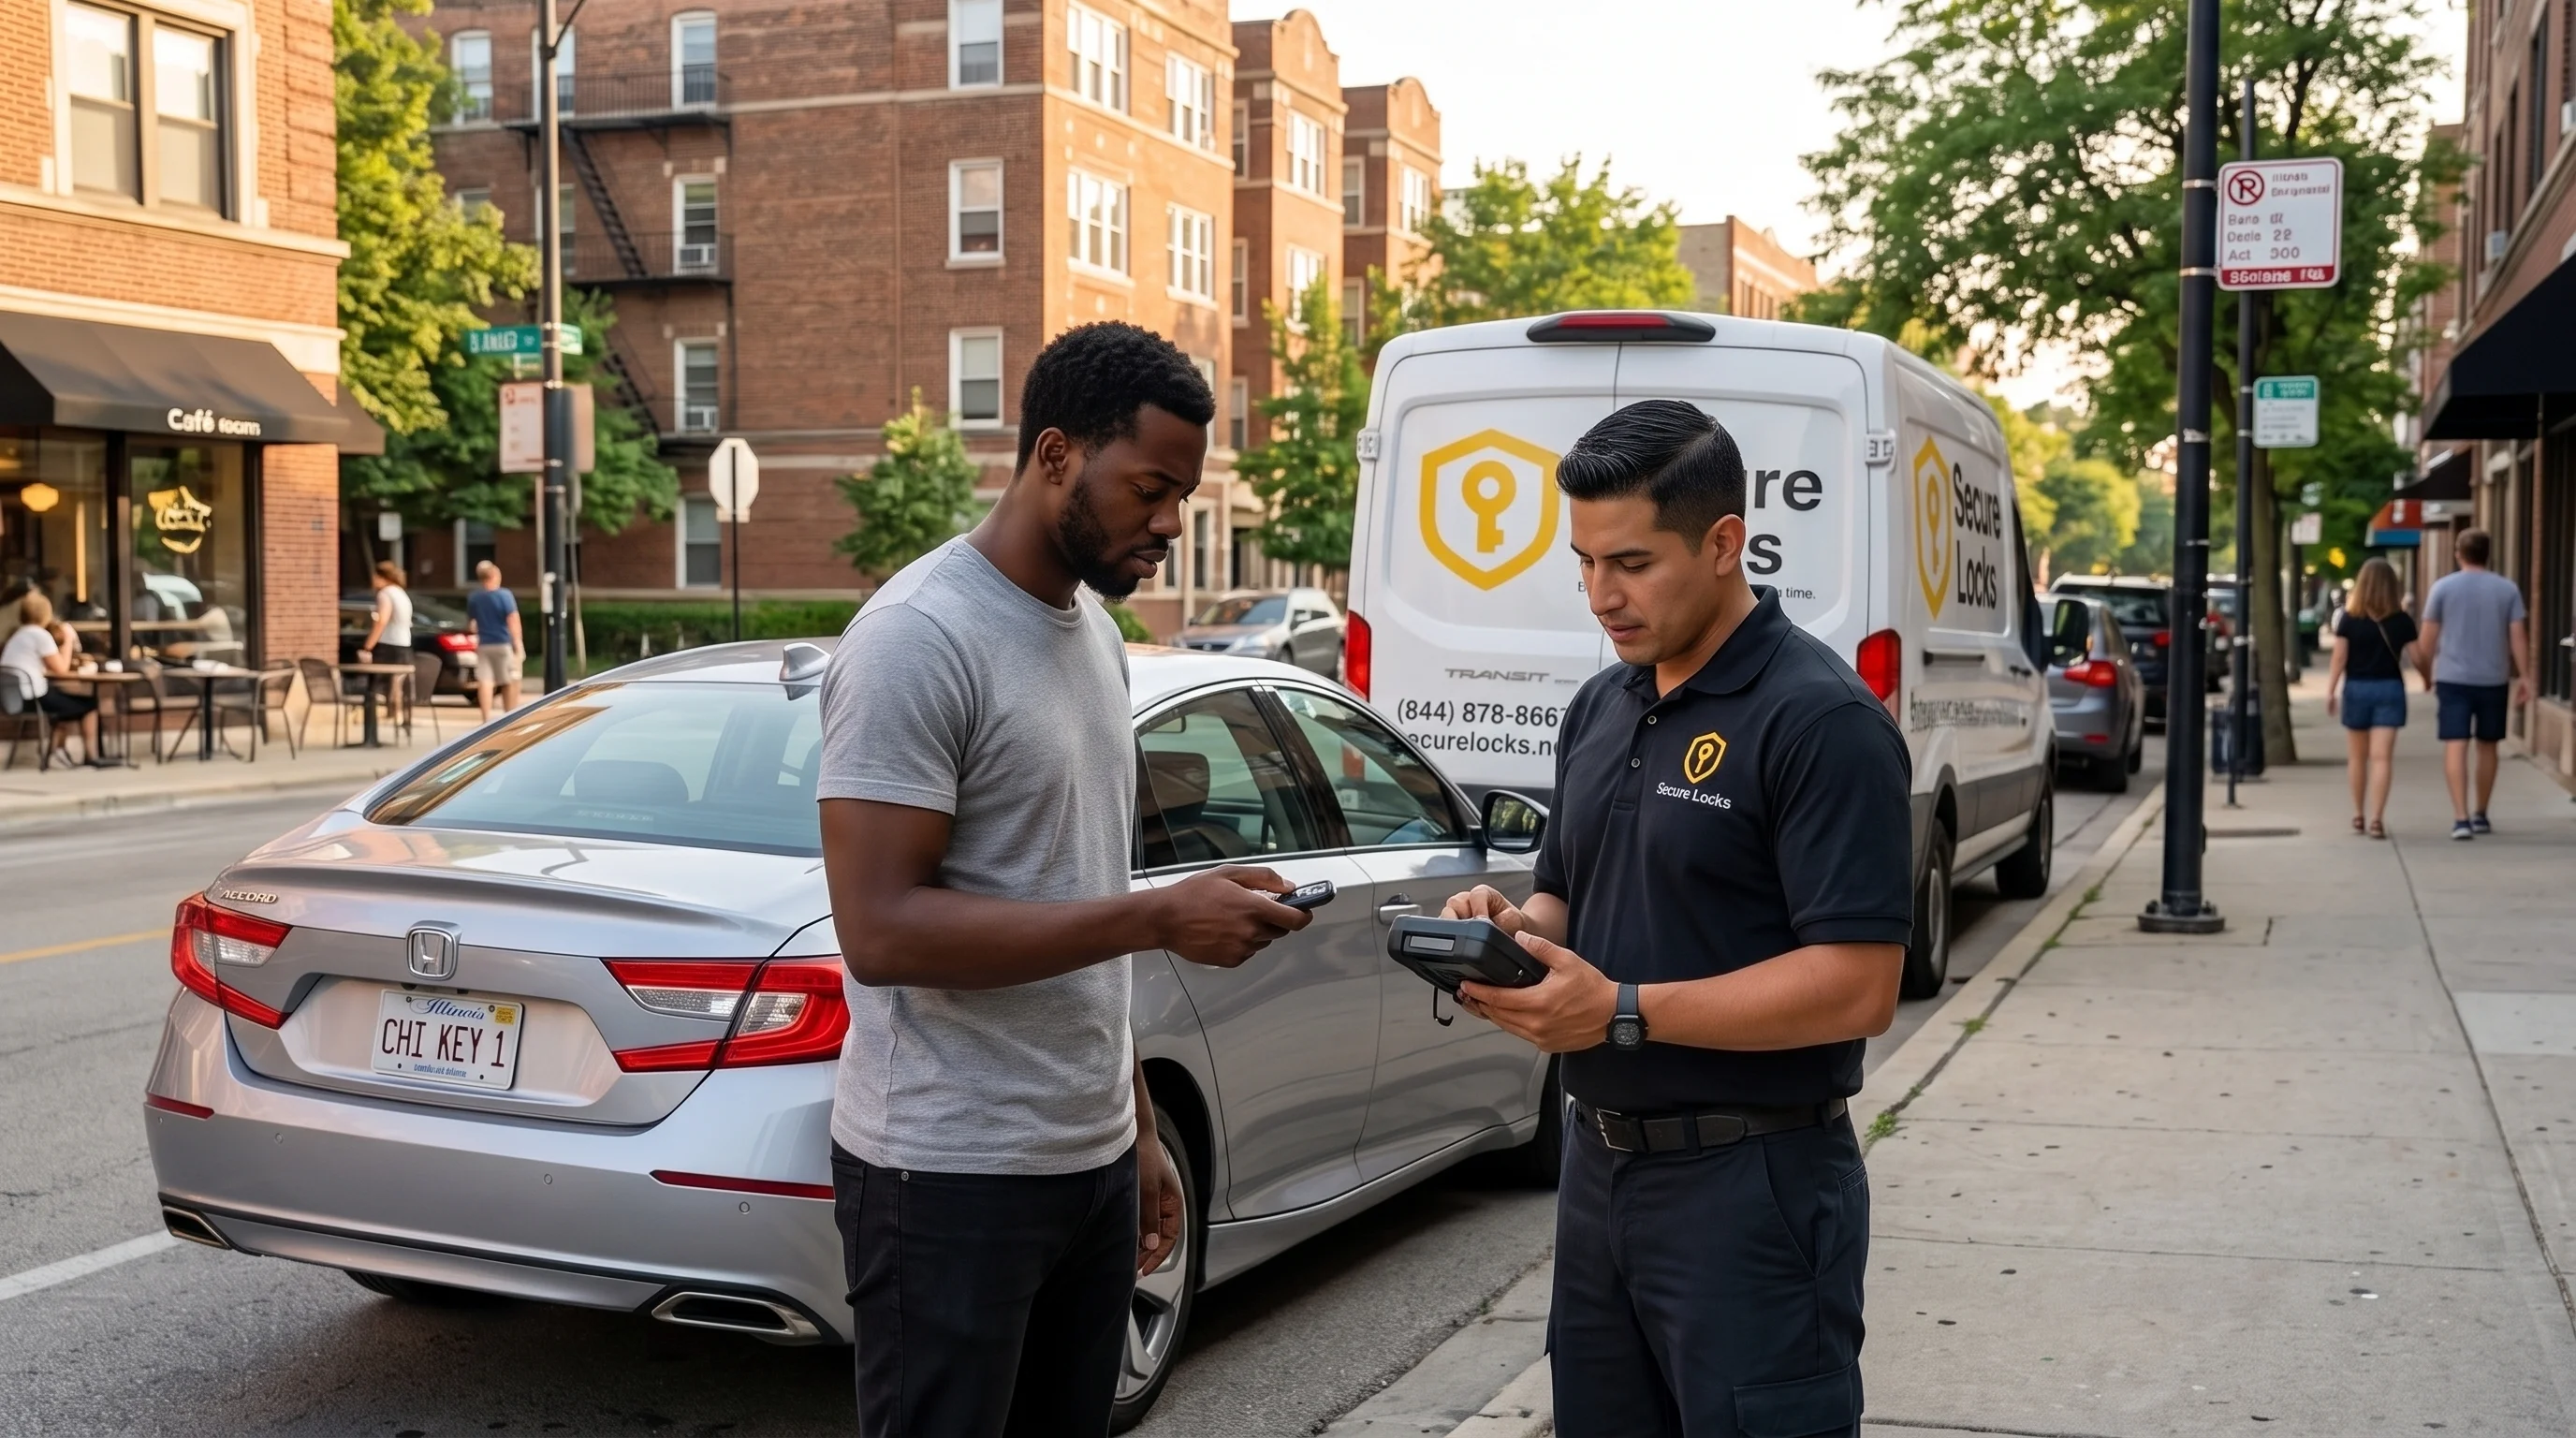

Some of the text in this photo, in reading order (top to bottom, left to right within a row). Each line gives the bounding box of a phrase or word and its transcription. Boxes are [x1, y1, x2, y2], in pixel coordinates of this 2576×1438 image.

[168, 407, 215, 433] Café
[1953, 462, 2001, 541] Secure
[1956, 539, 1997, 609] Locks
[1786, 586, 1816, 599] time.
[1444, 668, 1550, 682] TRANSIT
[1398, 698, 1455, 727] (844)
[1656, 782, 1732, 809] Secure Locks
[381, 1018, 505, 1068] CHI KEY 1
